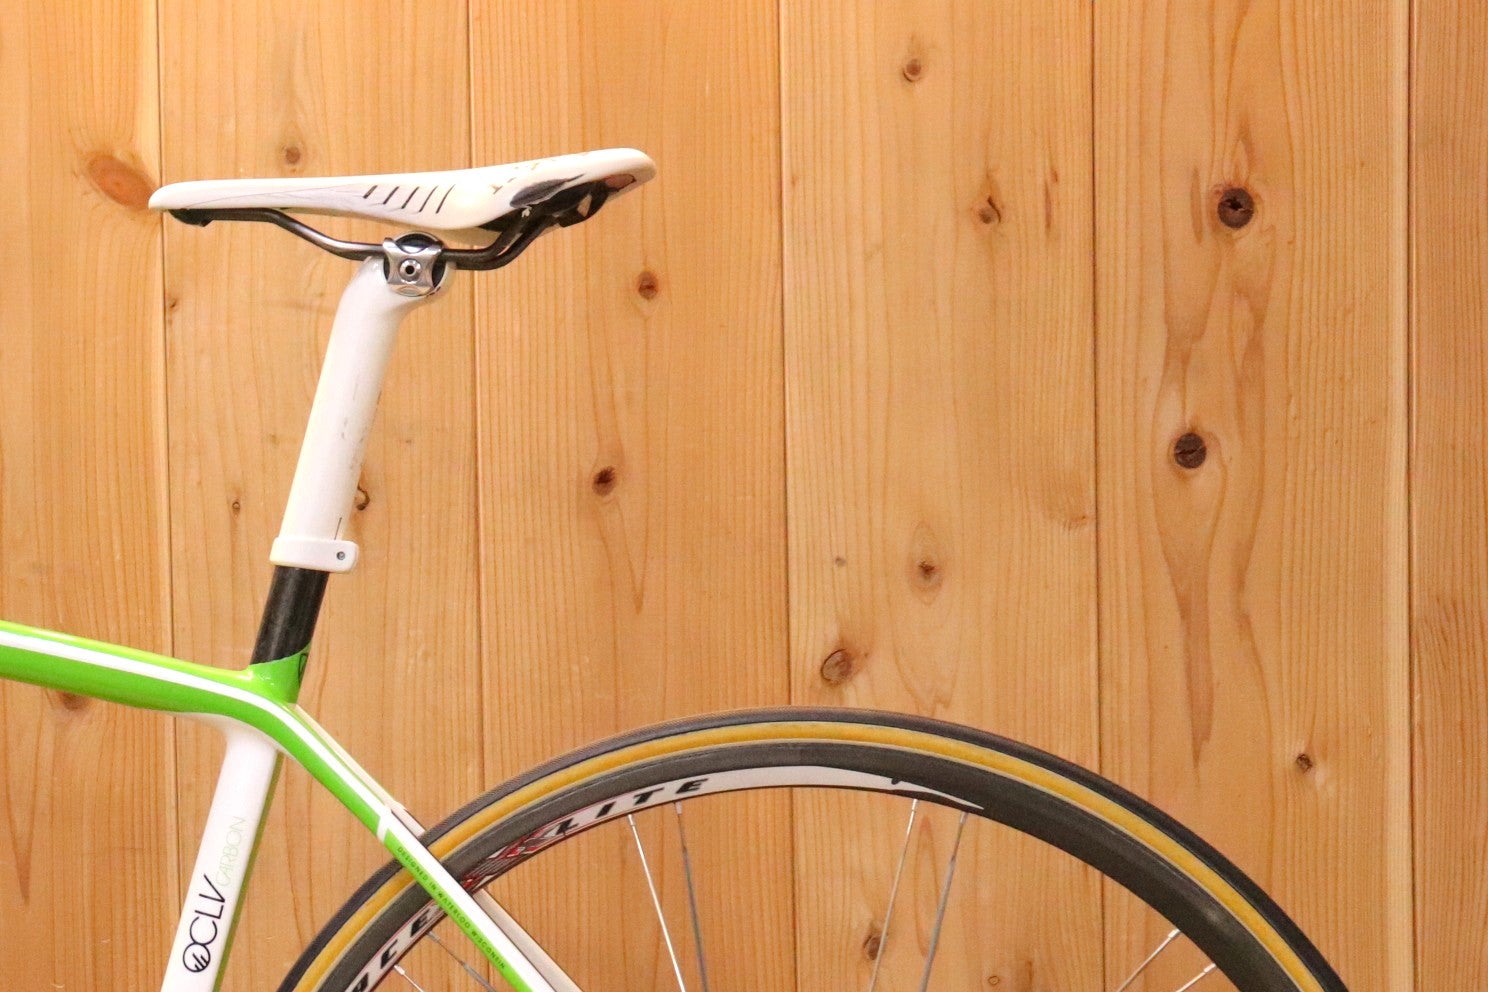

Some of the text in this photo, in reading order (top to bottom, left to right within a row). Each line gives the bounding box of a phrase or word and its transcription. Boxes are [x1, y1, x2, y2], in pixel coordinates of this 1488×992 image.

[555, 778, 708, 834] LITE
[215, 816, 247, 887] CARBON
[397, 847, 505, 969] DESIGNED IN WATERLOO WISCONSIN
